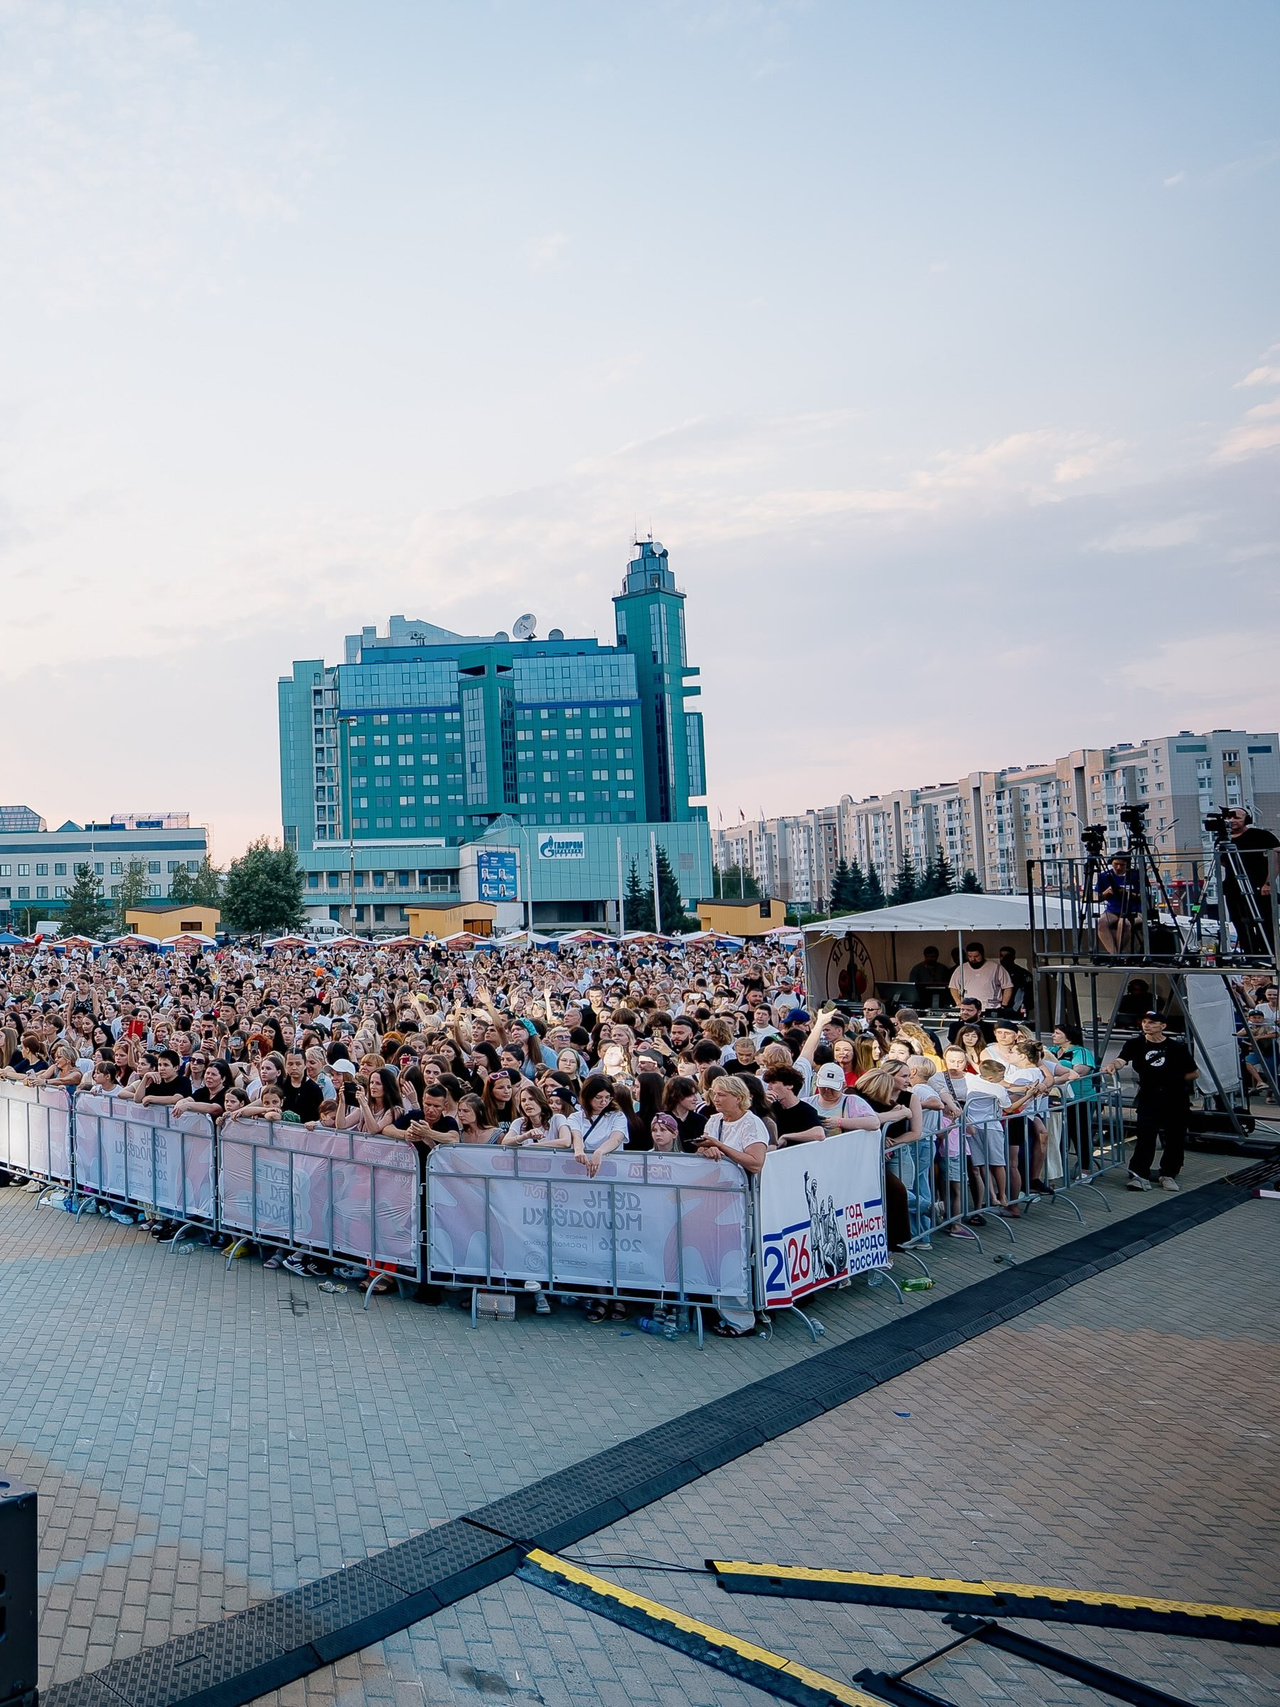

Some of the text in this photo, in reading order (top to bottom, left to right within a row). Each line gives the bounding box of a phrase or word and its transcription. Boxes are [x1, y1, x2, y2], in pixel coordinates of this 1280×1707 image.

[832, 937, 869, 967] ЯГОДЫ
[845, 1203, 863, 1220] ГОД
[847, 1233, 888, 1256] НАРОДО
[764, 1234, 811, 1293] 226
[849, 1250, 888, 1274] РОССИИ
